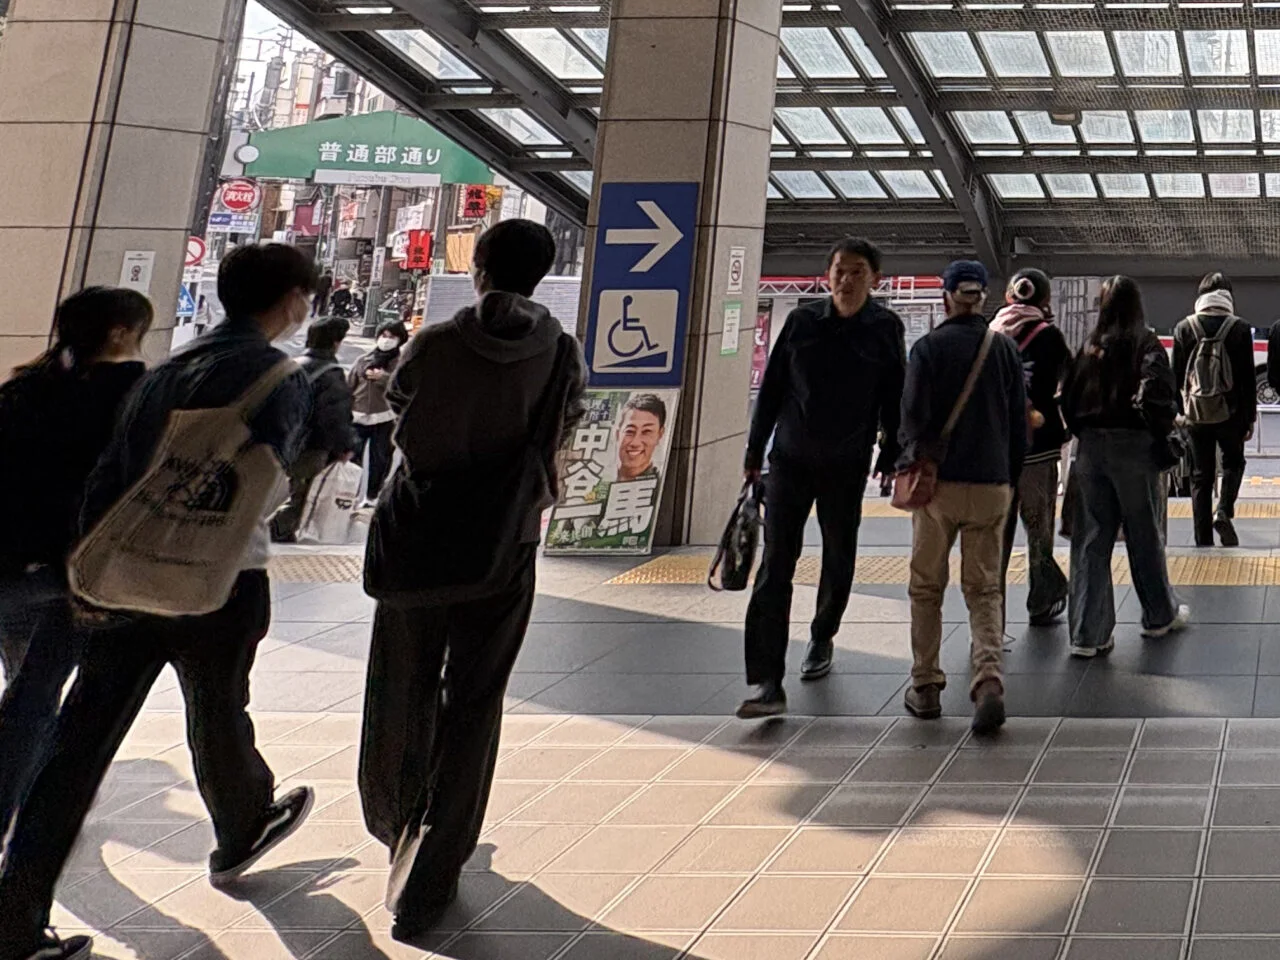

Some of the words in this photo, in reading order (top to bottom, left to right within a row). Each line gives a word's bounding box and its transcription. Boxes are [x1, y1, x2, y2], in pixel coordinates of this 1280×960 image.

[319, 141, 441, 166] 普通部通り
[224, 190, 254, 203] 消火栓
